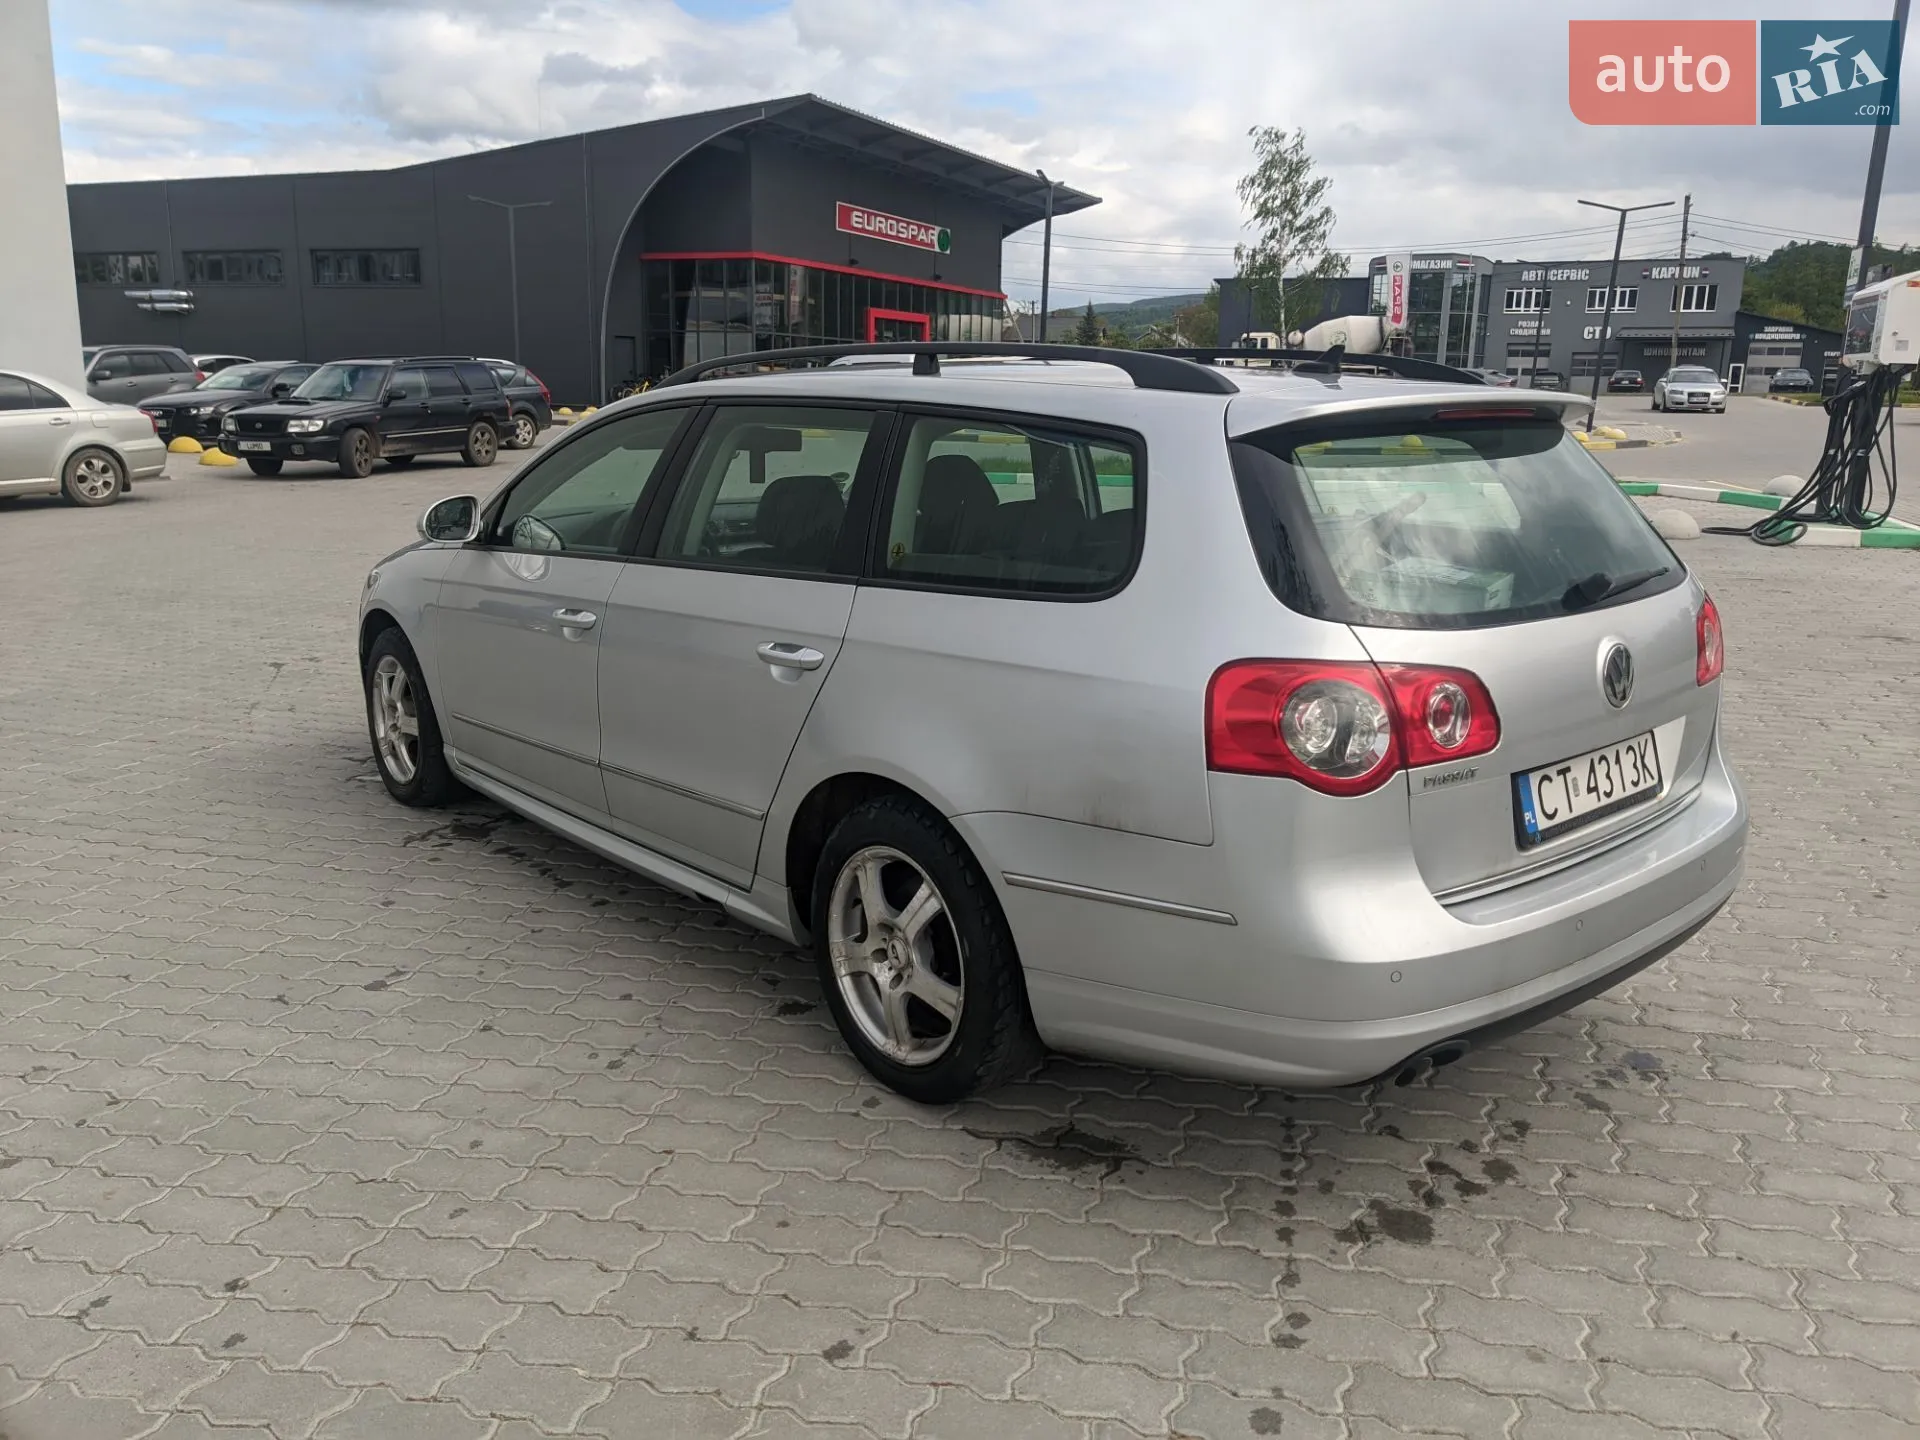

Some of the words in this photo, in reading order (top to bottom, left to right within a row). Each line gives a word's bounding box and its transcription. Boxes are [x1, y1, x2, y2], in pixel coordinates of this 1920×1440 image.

[851, 210, 936, 245] EUROSPAR
[1410, 259, 1453, 270] МАГАЗИН
[1537, 765, 1573, 821] CT
[1586, 738, 1655, 802] 4313K
[1524, 811, 1536, 826] PL
